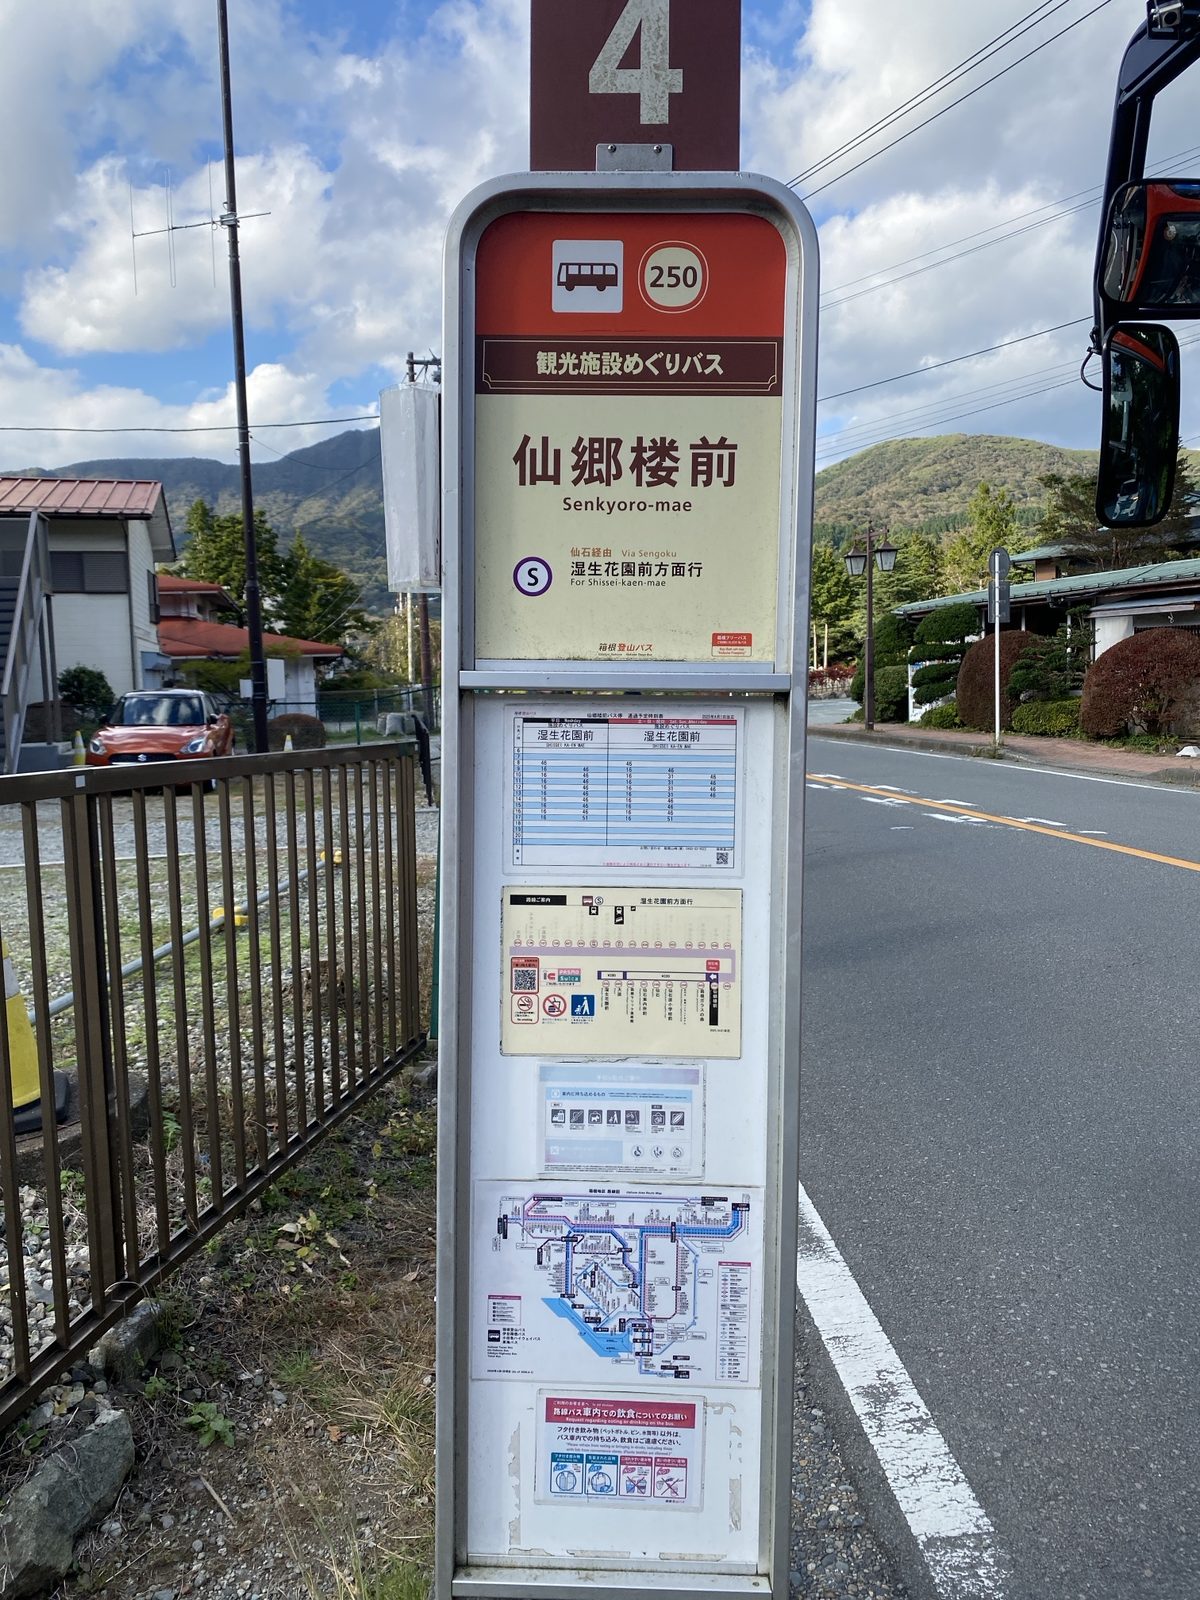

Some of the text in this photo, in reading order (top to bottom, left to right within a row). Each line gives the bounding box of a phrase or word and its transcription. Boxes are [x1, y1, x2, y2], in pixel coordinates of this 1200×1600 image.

[588, 0, 683, 124] 4
[650, 266, 698, 288] 250
[537, 351, 723, 376] 観光施設めぐりバス
[513, 434, 738, 487] 仙郷楼前
[563, 497, 692, 514] Senkyoro-mae
[570, 547, 677, 559] 仙石経由 Via Sengoku
[528, 567, 539, 586] S
[571, 562, 703, 577] 湿生花園前方面行
[571, 578, 666, 586] For Shissei-kaen-mae
[599, 642, 652, 652] 箱根登山バス
[538, 730, 593, 741] 湿生花園前
[644, 731, 700, 742] 湿生花園前
[554, 1407, 687, 1420] 路線バス車内での飲食についてのお願い
